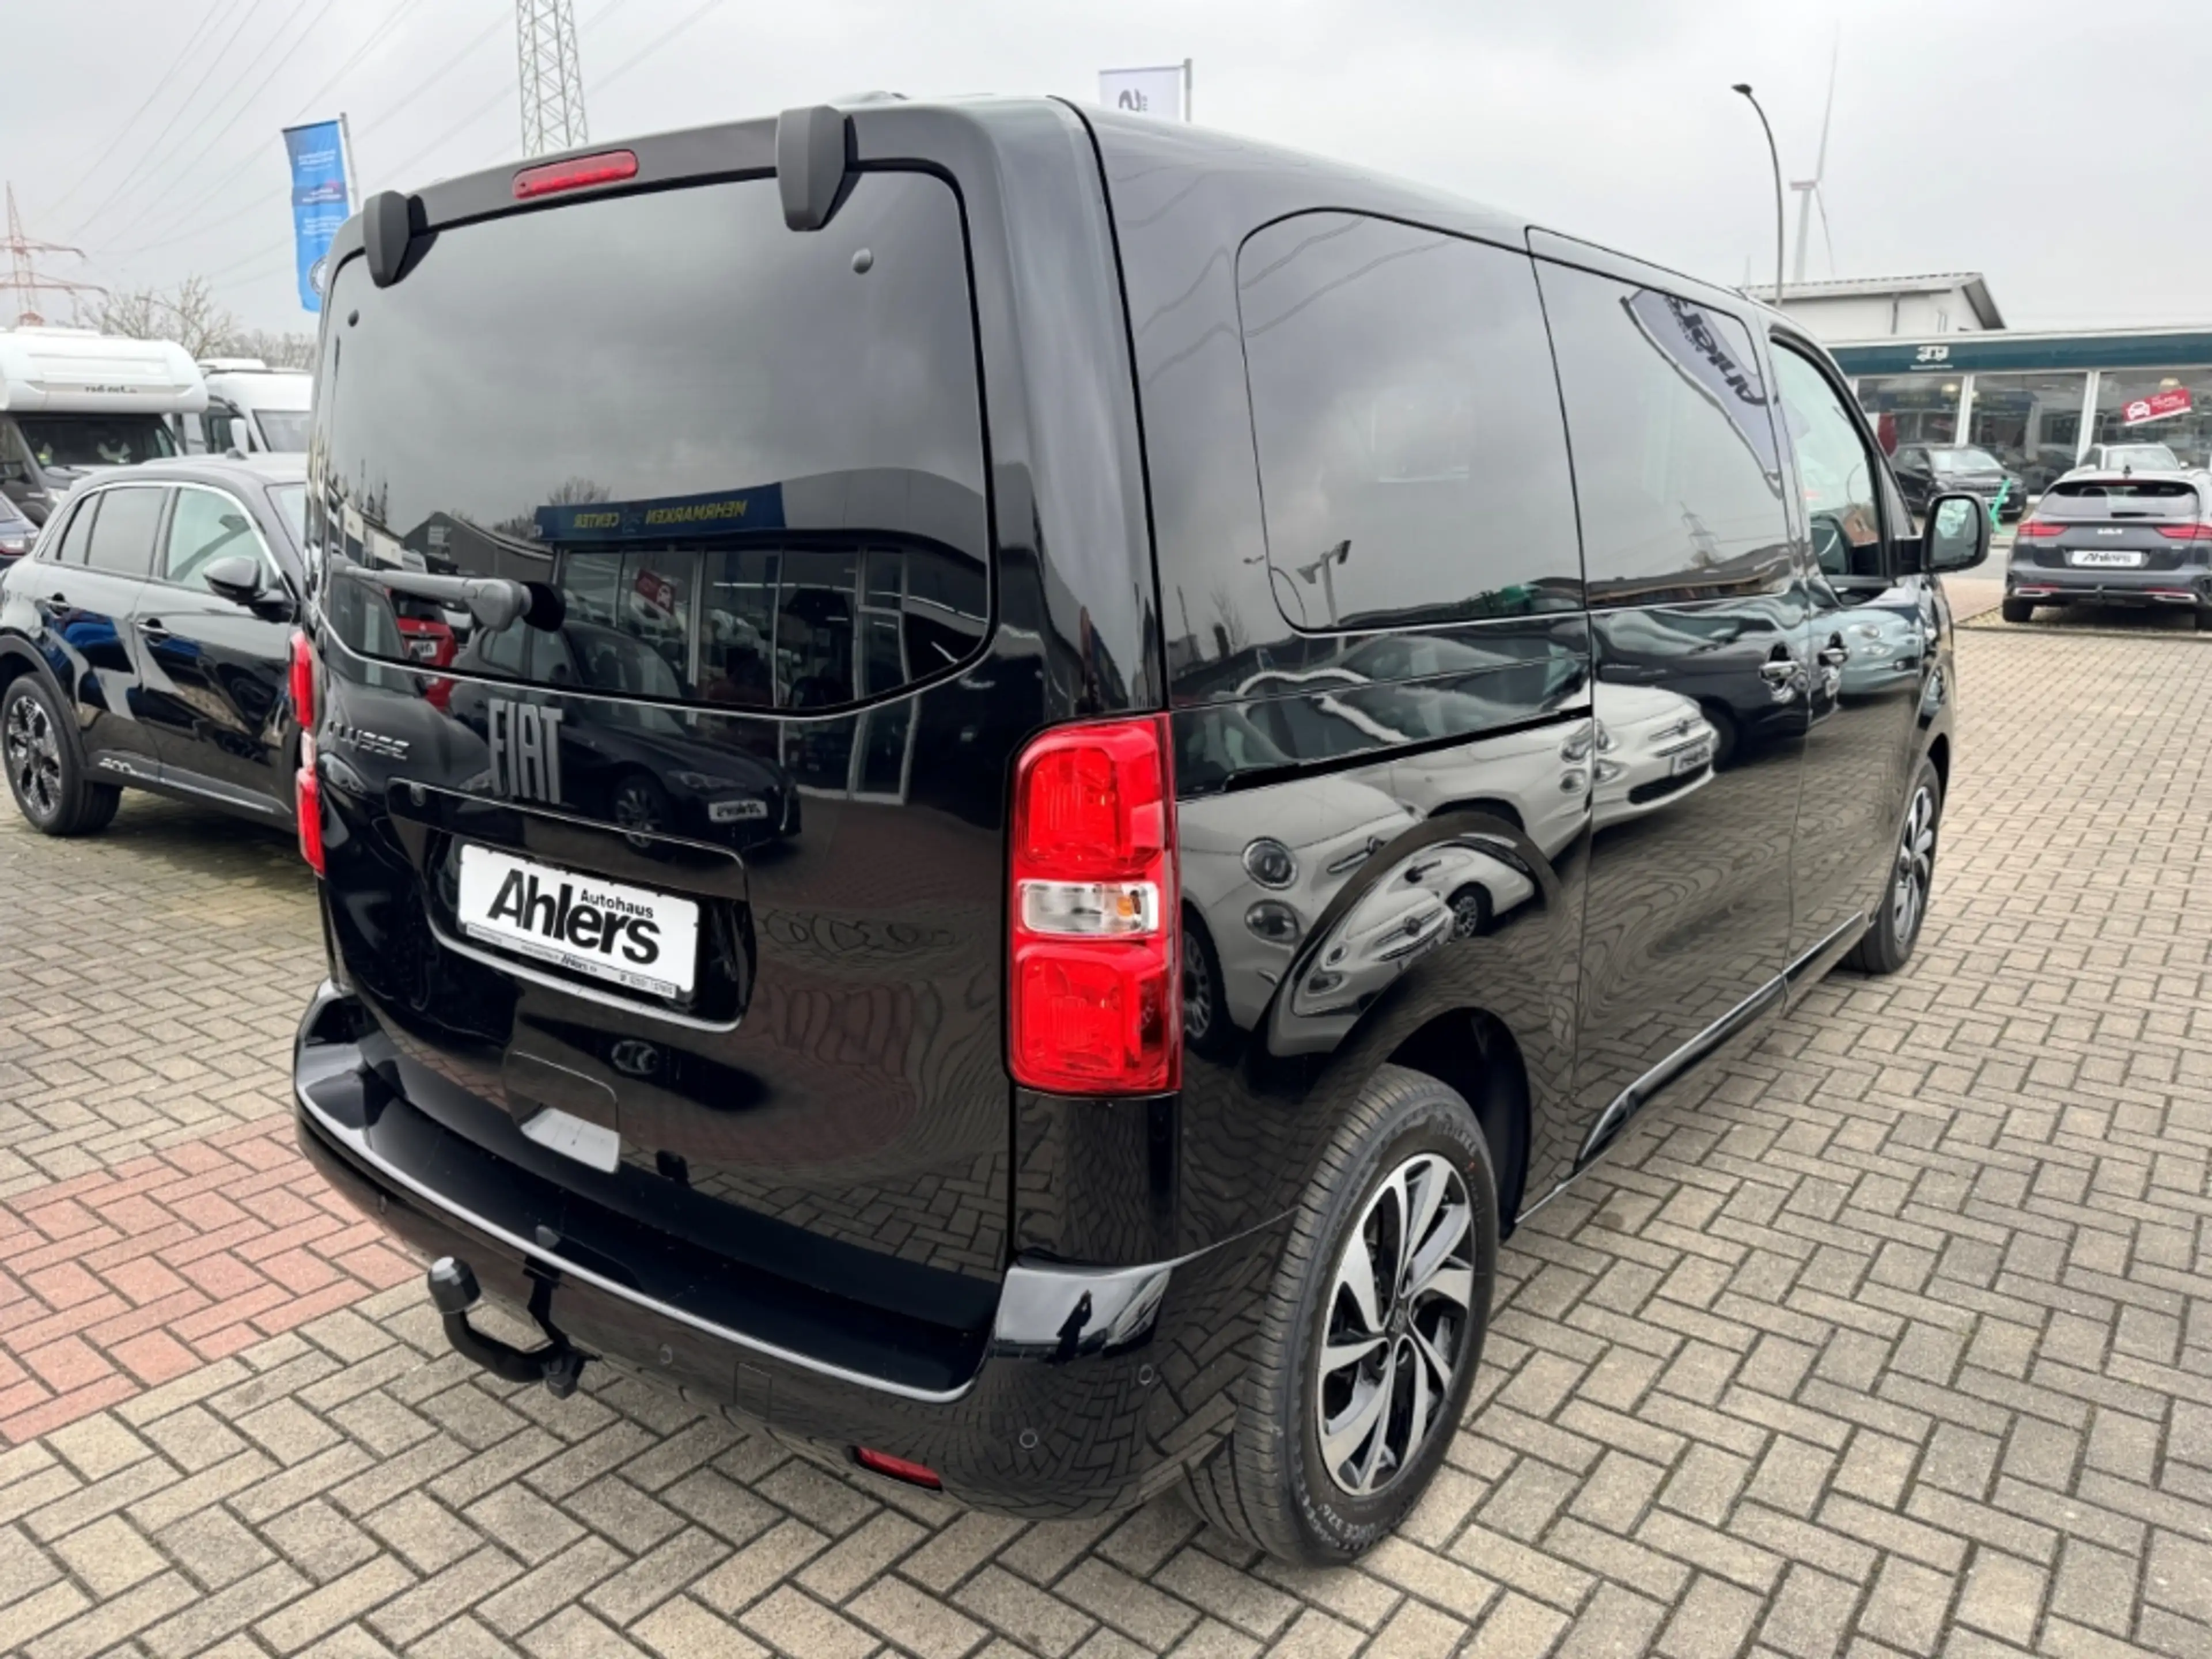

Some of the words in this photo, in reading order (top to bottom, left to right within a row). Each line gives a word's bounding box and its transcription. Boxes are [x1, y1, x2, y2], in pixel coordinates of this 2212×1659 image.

[490, 698, 563, 805] FIAT
[486, 868, 661, 965] Ahlers
[581, 889, 654, 918] Autohaus
